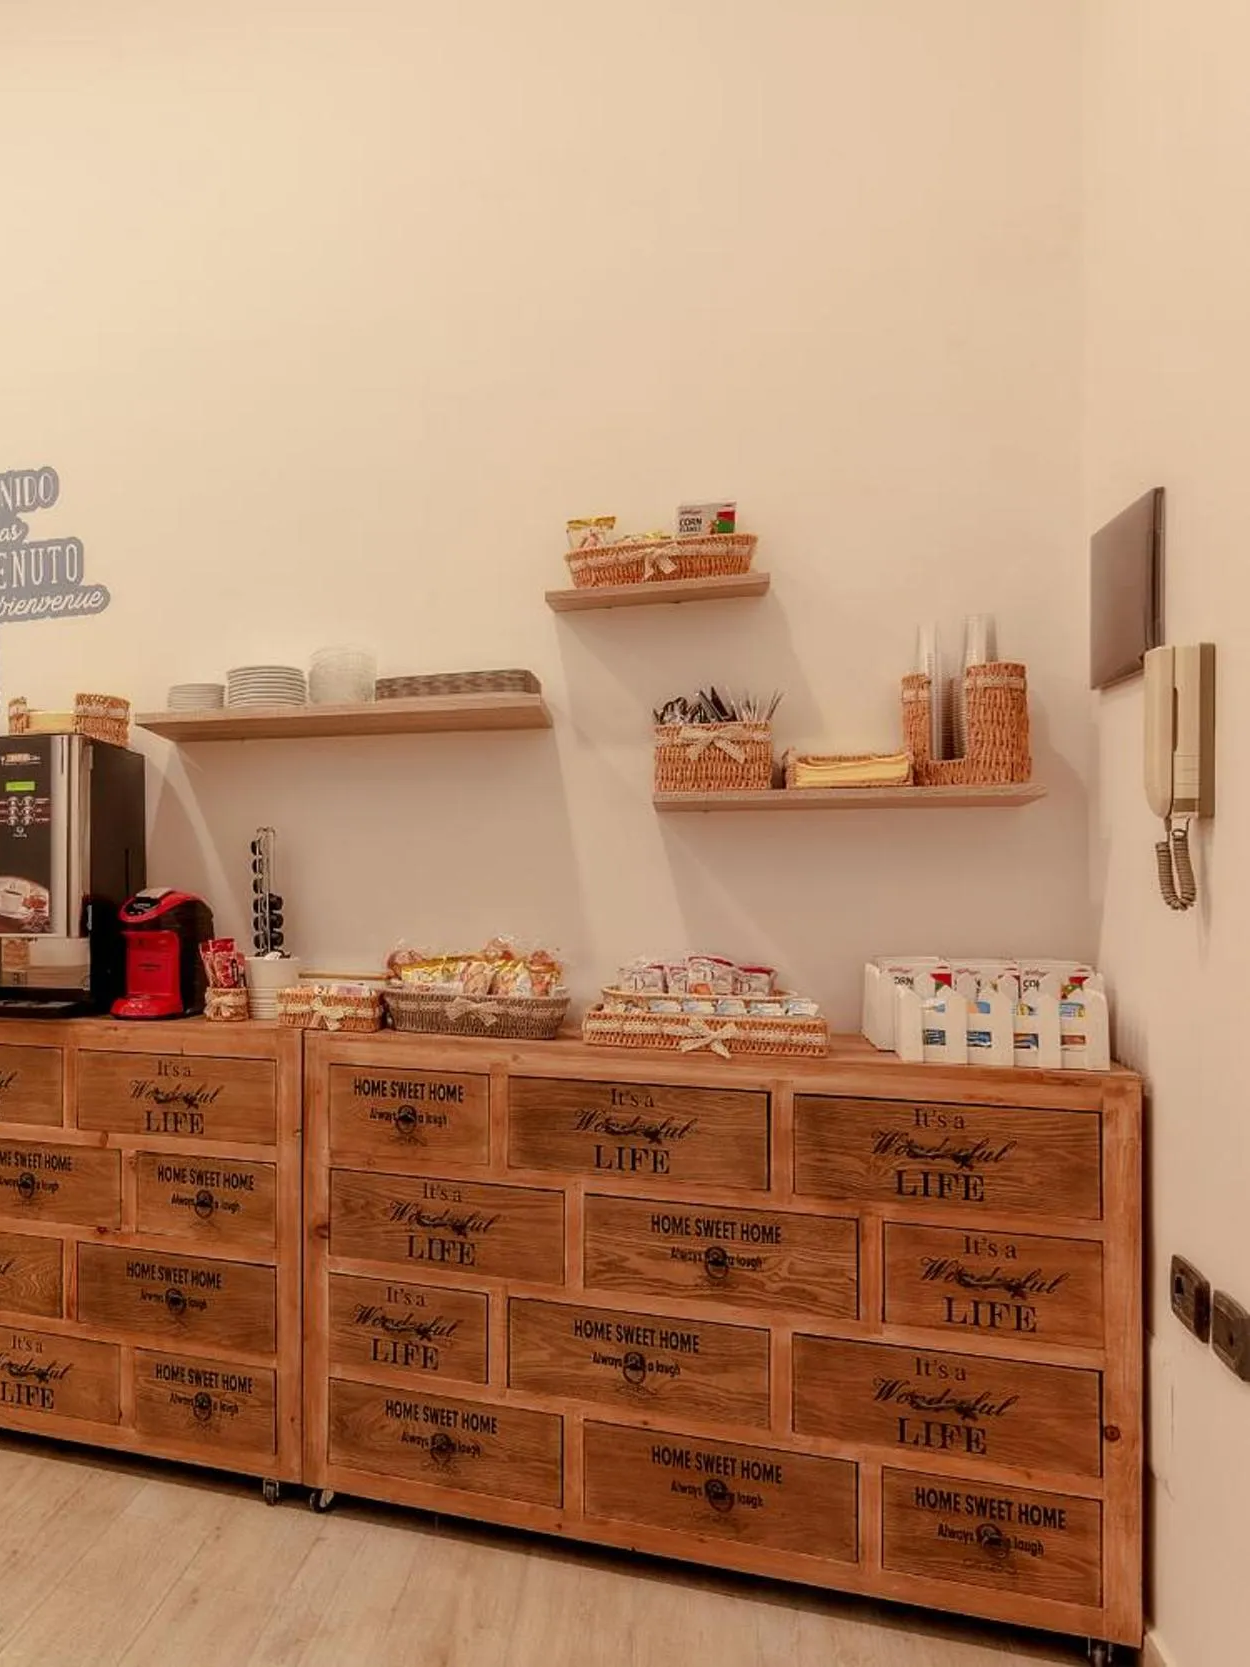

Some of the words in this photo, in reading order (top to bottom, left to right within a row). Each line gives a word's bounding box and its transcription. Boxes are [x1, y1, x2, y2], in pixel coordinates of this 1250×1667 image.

[679, 516, 702, 526] CORN
[157, 1060, 181, 1077] It's
[354, 1078, 387, 1097] HOME
[391, 1081, 425, 1100] SWEET
[430, 1084, 464, 1103] HOME
[611, 1087, 639, 1107] It's
[145, 1110, 205, 1135] LIFE
[913, 1107, 947, 1129] It's
[13, 1151, 42, 1169] SWEET
[44, 1154, 72, 1172] HOME
[593, 1144, 671, 1174] LIFE
[157, 1166, 186, 1184] HOME
[188, 1168, 221, 1188] SWEET
[222, 1171, 254, 1191] HOME
[422, 1182, 448, 1200] It's
[895, 1169, 985, 1202] LIFE
[651, 1215, 691, 1235] HOME
[695, 1219, 737, 1240] SWEET
[741, 1223, 782, 1244] HOME
[406, 1234, 477, 1266] LIFE
[963, 1235, 998, 1256] It's
[126, 1263, 156, 1281] HOME
[157, 1265, 189, 1285] SWEET
[191, 1270, 222, 1289] HOME
[386, 1286, 412, 1307] It's
[943, 1296, 1038, 1333] LIFE
[11, 1334, 33, 1350] It's
[574, 1319, 612, 1342] HOME
[616, 1324, 656, 1347] SWEET
[659, 1330, 700, 1353] HOME
[371, 1338, 440, 1371] LIFE
[156, 1363, 186, 1383] HOME
[188, 1366, 219, 1388] SWEET
[222, 1371, 253, 1394] HOME
[915, 1357, 949, 1379] It's
[955, 1367, 966, 1381] a
[0, 1381, 55, 1410] LIFE
[385, 1400, 419, 1422] HOME
[423, 1405, 459, 1428] SWEET
[462, 1412, 497, 1434] HOME
[897, 1417, 987, 1455] LIFE
[652, 1445, 691, 1469] HOME
[695, 1452, 737, 1477] SWEET
[741, 1460, 782, 1484] HOME
[914, 1486, 961, 1513] HOME
[965, 1494, 1014, 1521] SWEET
[1018, 1503, 1067, 1530] HOME
